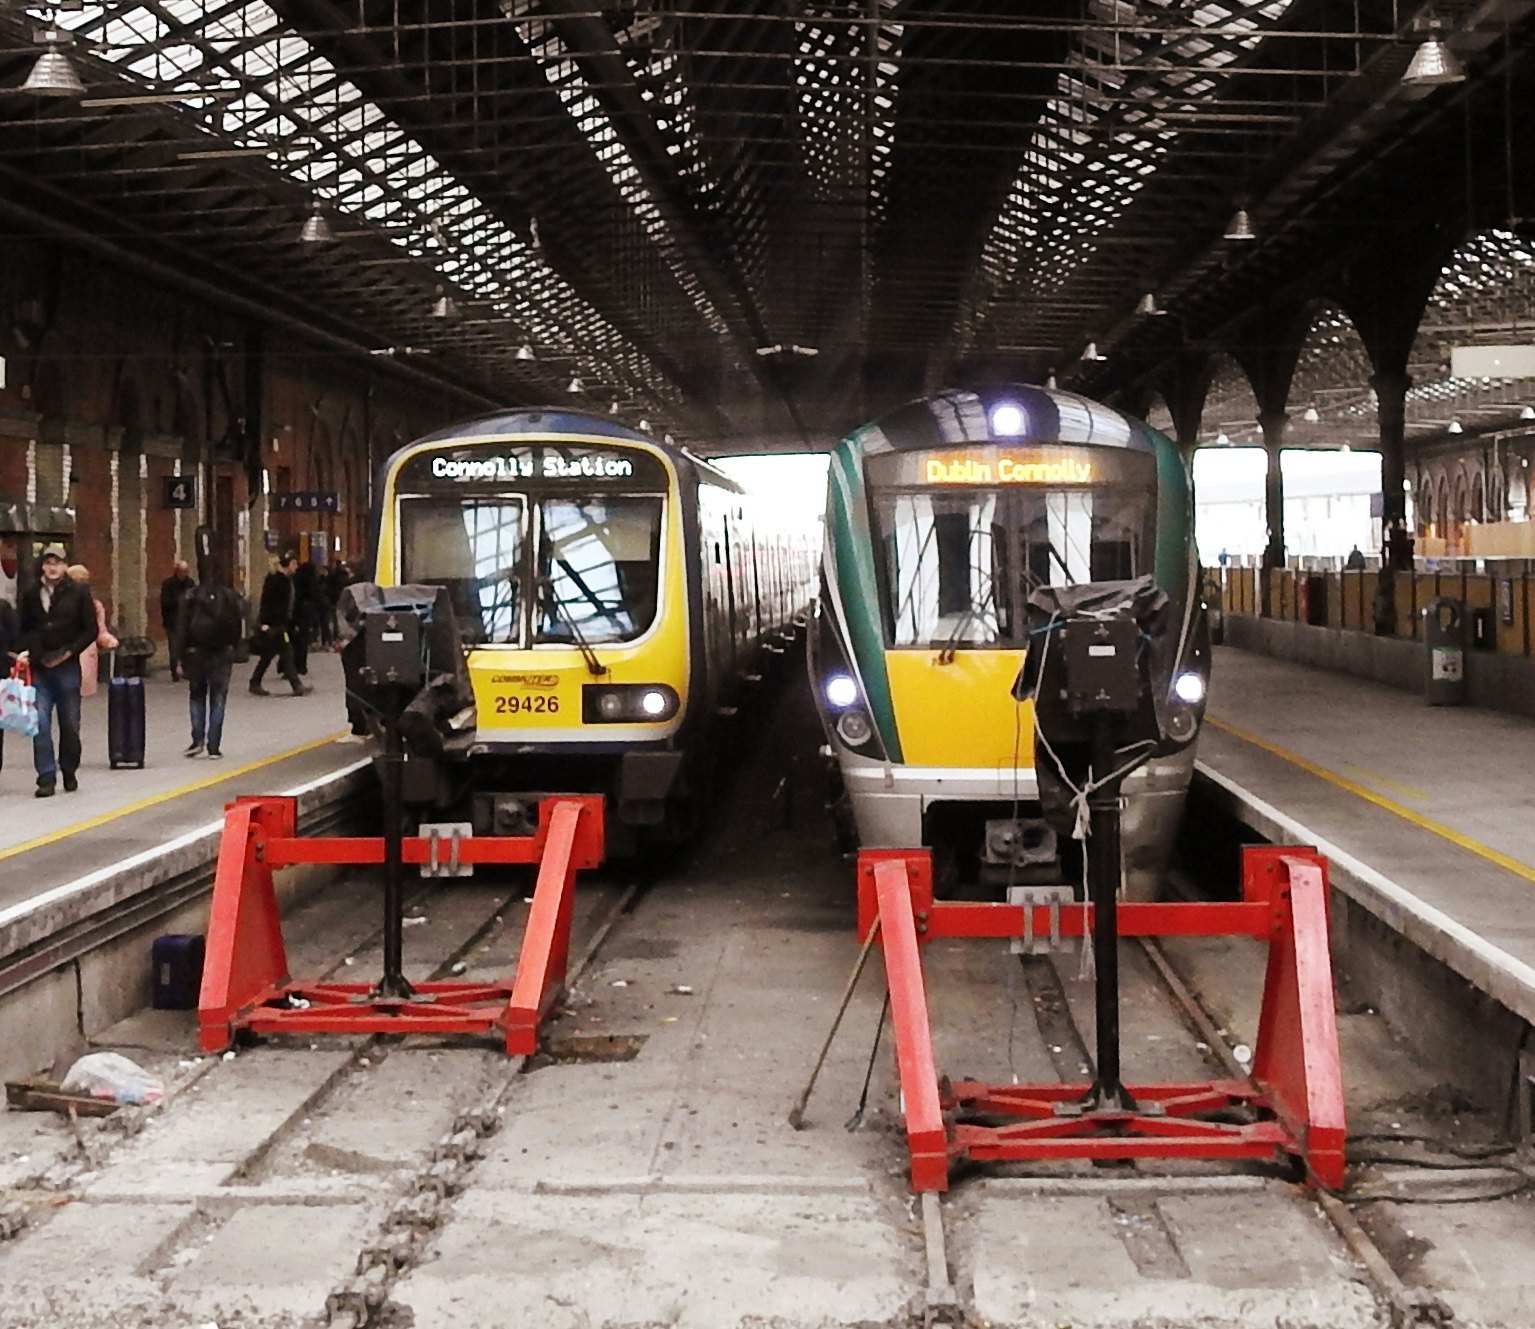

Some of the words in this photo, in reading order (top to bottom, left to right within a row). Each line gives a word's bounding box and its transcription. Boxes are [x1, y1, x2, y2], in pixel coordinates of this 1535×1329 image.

[432, 458, 534, 477] Connolly
[543, 456, 633, 476] Station
[927, 459, 992, 482] Dublin
[997, 459, 1091, 483] Connolly
[172, 483, 187, 501] 4
[495, 696, 559, 713] 29426
